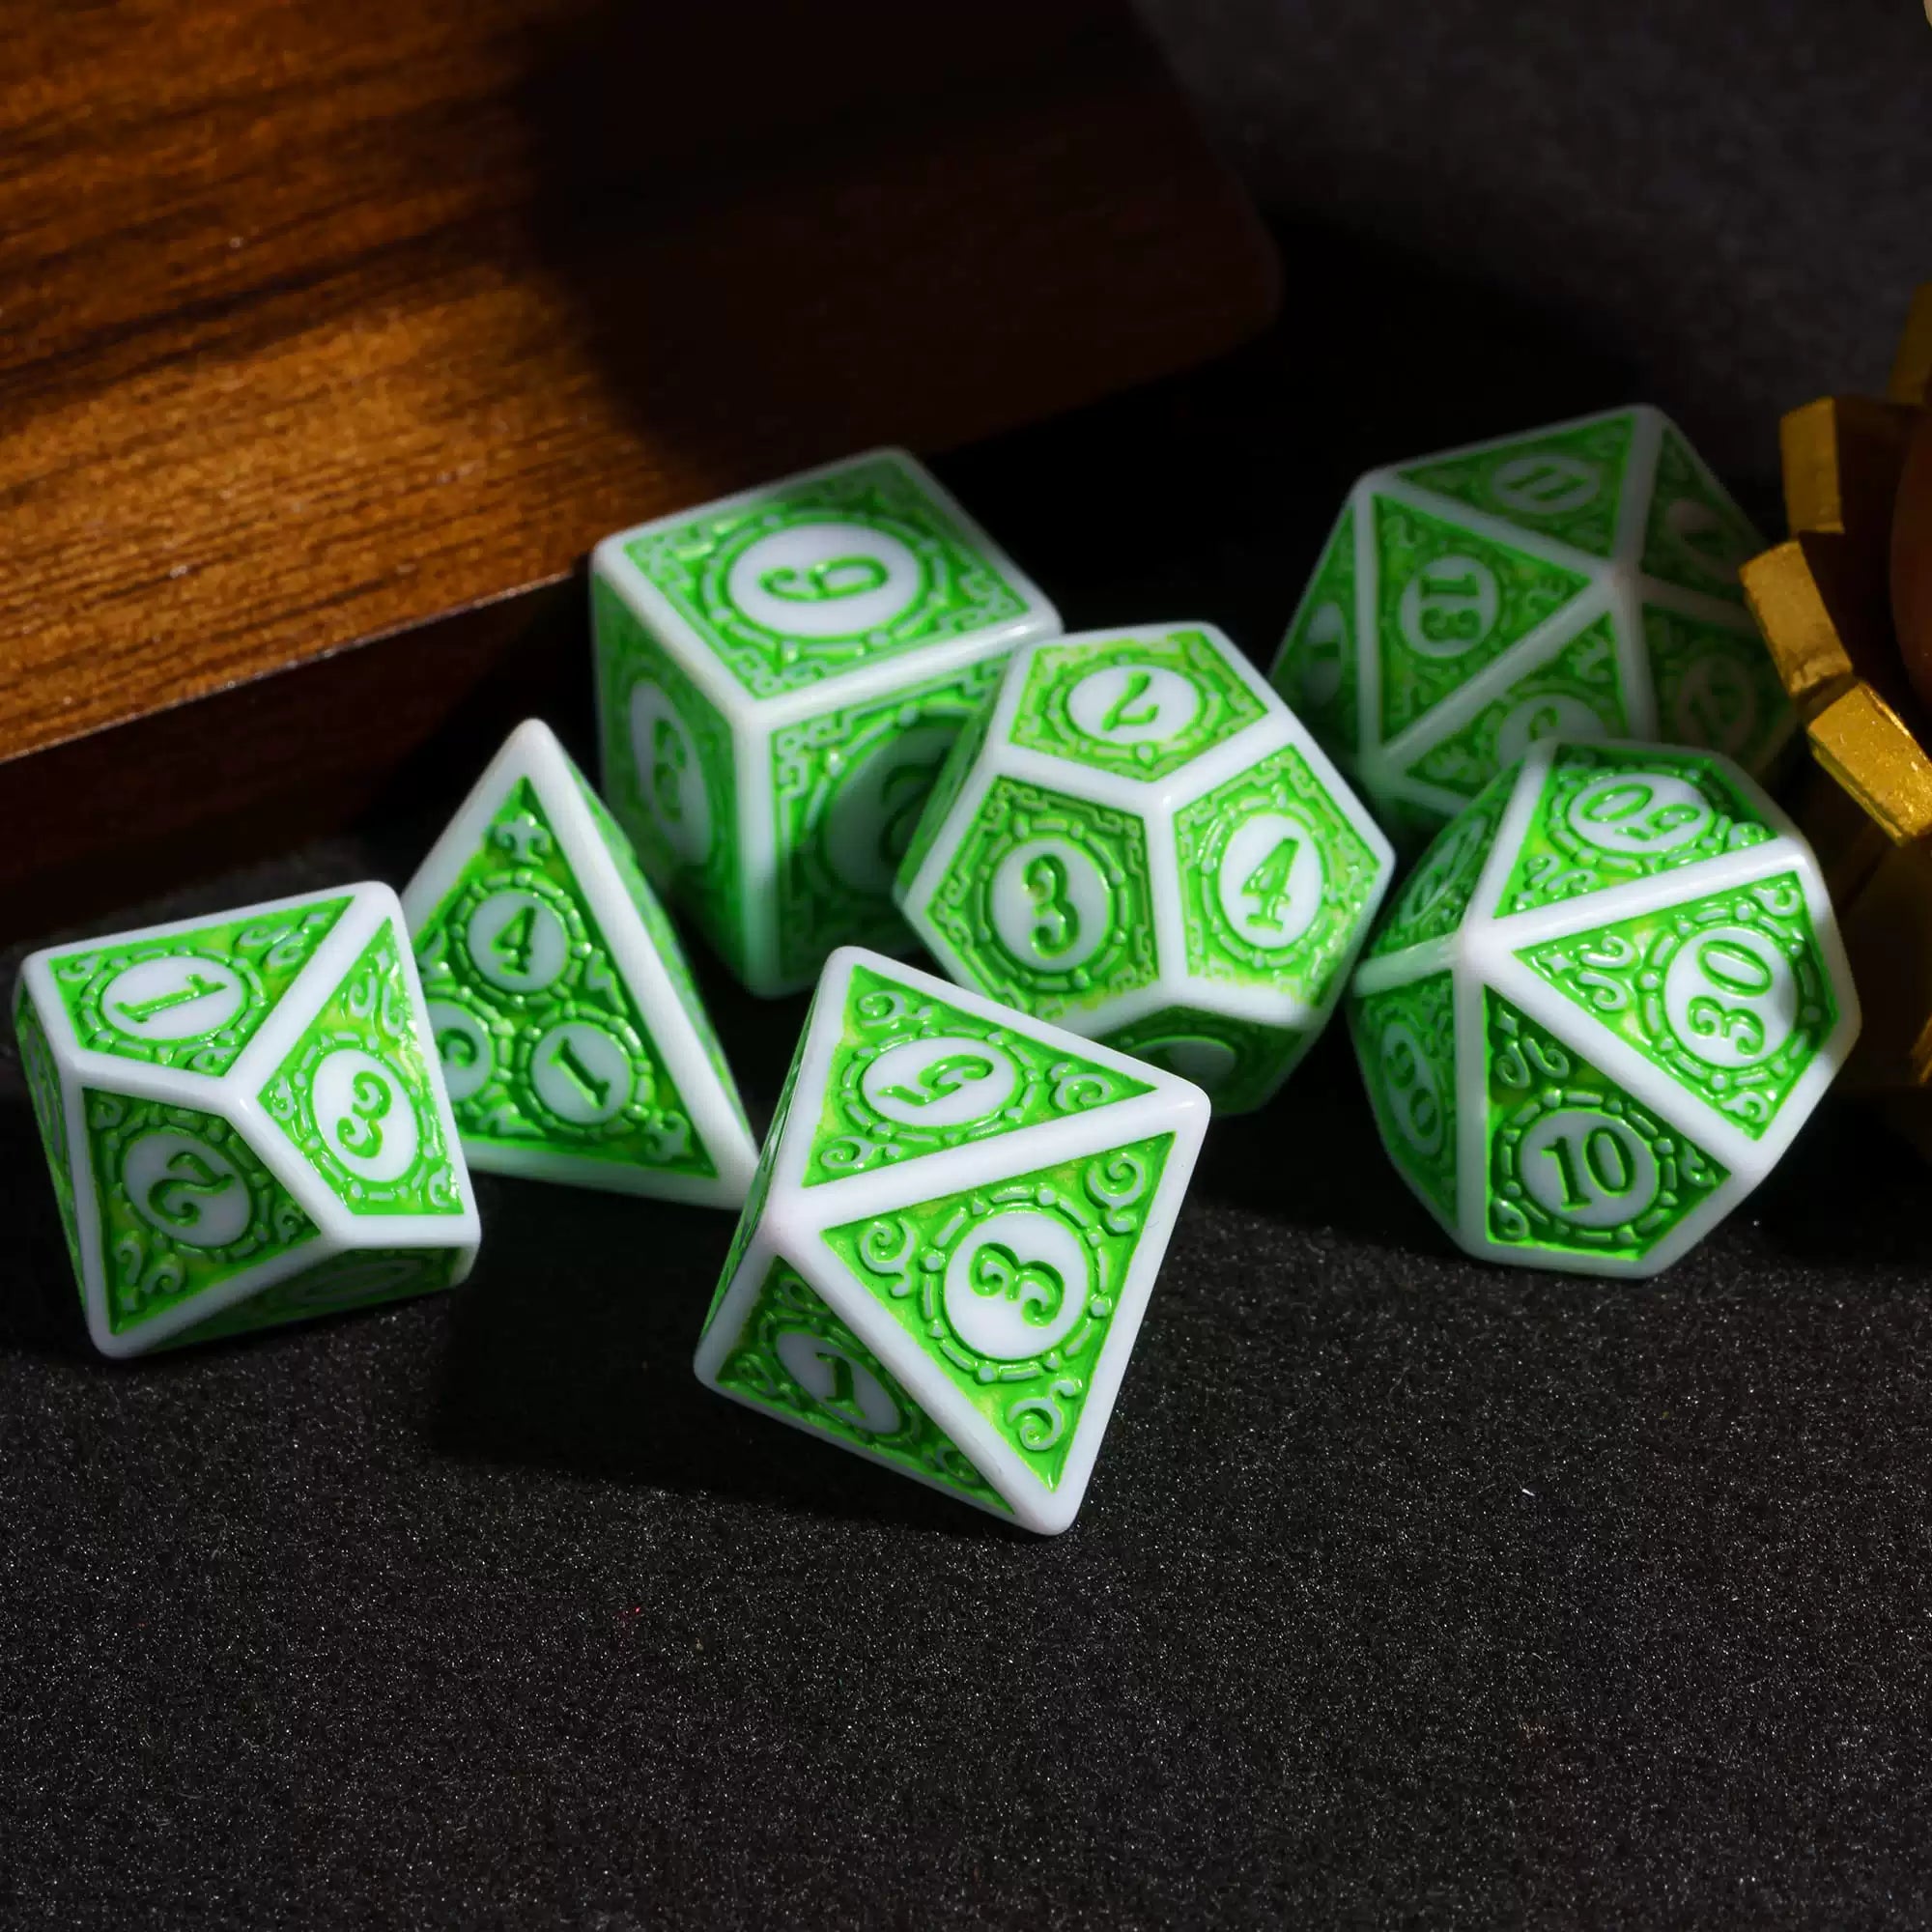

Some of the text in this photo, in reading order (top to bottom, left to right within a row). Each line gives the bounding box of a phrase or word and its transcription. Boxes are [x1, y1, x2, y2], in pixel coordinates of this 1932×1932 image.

[1507, 465, 1588, 502] 11
[761, 555, 888, 601] 6
[1419, 572, 1481, 641] 13
[1102, 672, 1159, 731] 7
[1580, 783, 1700, 840] 50
[1023, 855, 1079, 959] 3
[1242, 838, 1299, 932] 4
[492, 906, 535, 976] 4
[114, 974, 228, 1023] 1
[1688, 939, 1772, 1055] 30
[554, 1038, 611, 1109] 1
[877, 1054, 994, 1107] 5
[336, 1072, 392, 1159] 3
[149, 1151, 236, 1227] 2
[1542, 1127, 1634, 1209] 10
[970, 1241, 1065, 1328] 3
